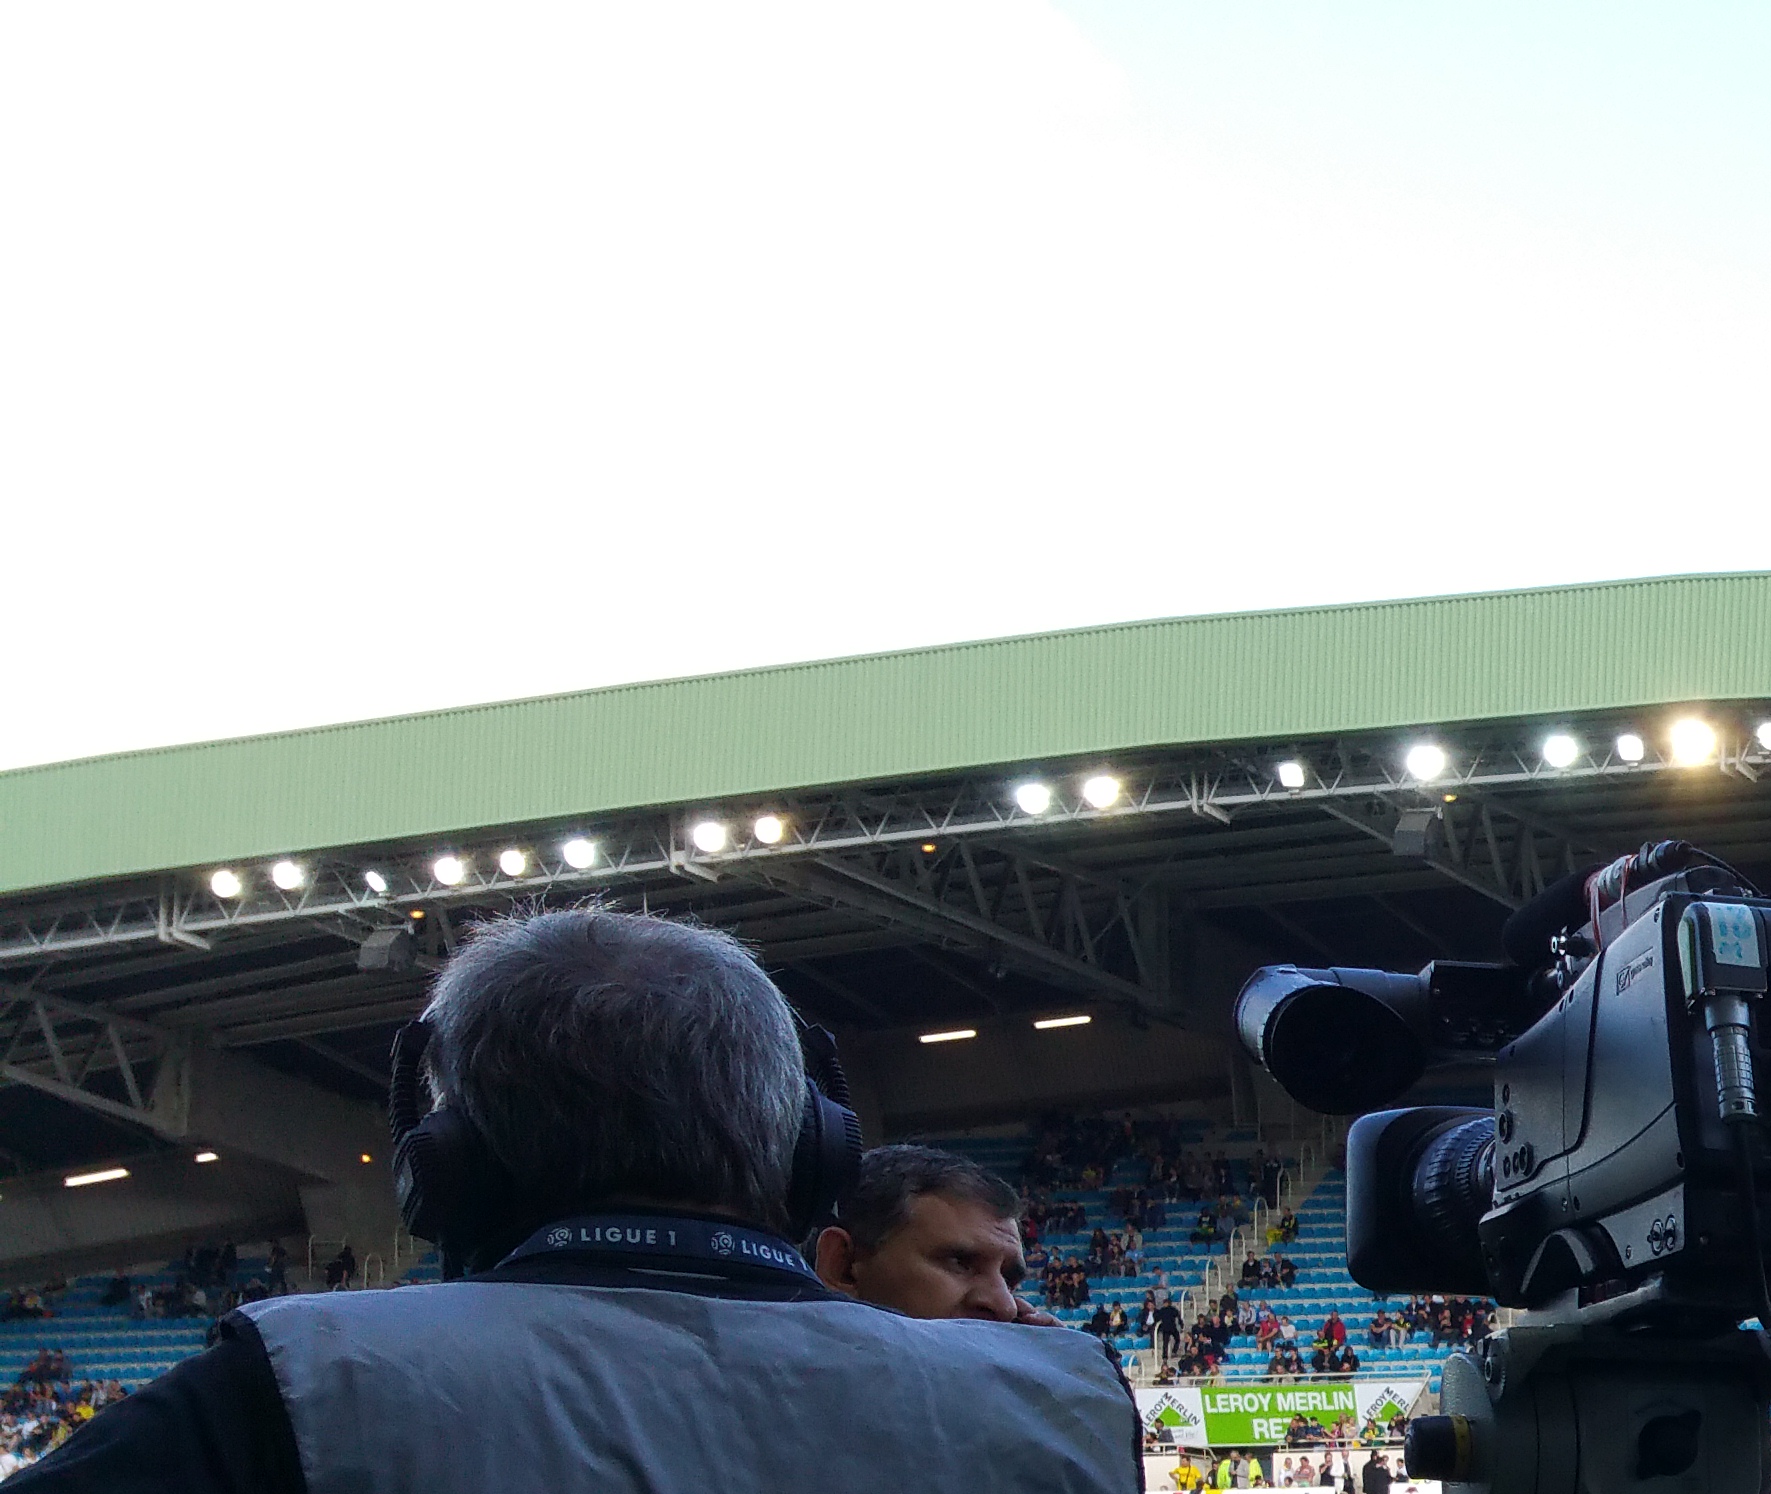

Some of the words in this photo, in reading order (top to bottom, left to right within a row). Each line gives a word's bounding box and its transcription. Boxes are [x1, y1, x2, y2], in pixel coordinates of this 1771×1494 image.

[580, 1227, 657, 1245] LIGUE
[668, 1230, 678, 1247] 1
[741, 1239, 795, 1268] LIGUE
[1143, 1398, 1168, 1432] LEROY
[1162, 1391, 1201, 1426] MERLIN
[1203, 1391, 1272, 1414] LEROY
[1276, 1390, 1355, 1412] MERLIN
[1361, 1391, 1390, 1422] LEROY
[1384, 1385, 1412, 1416] MERL
